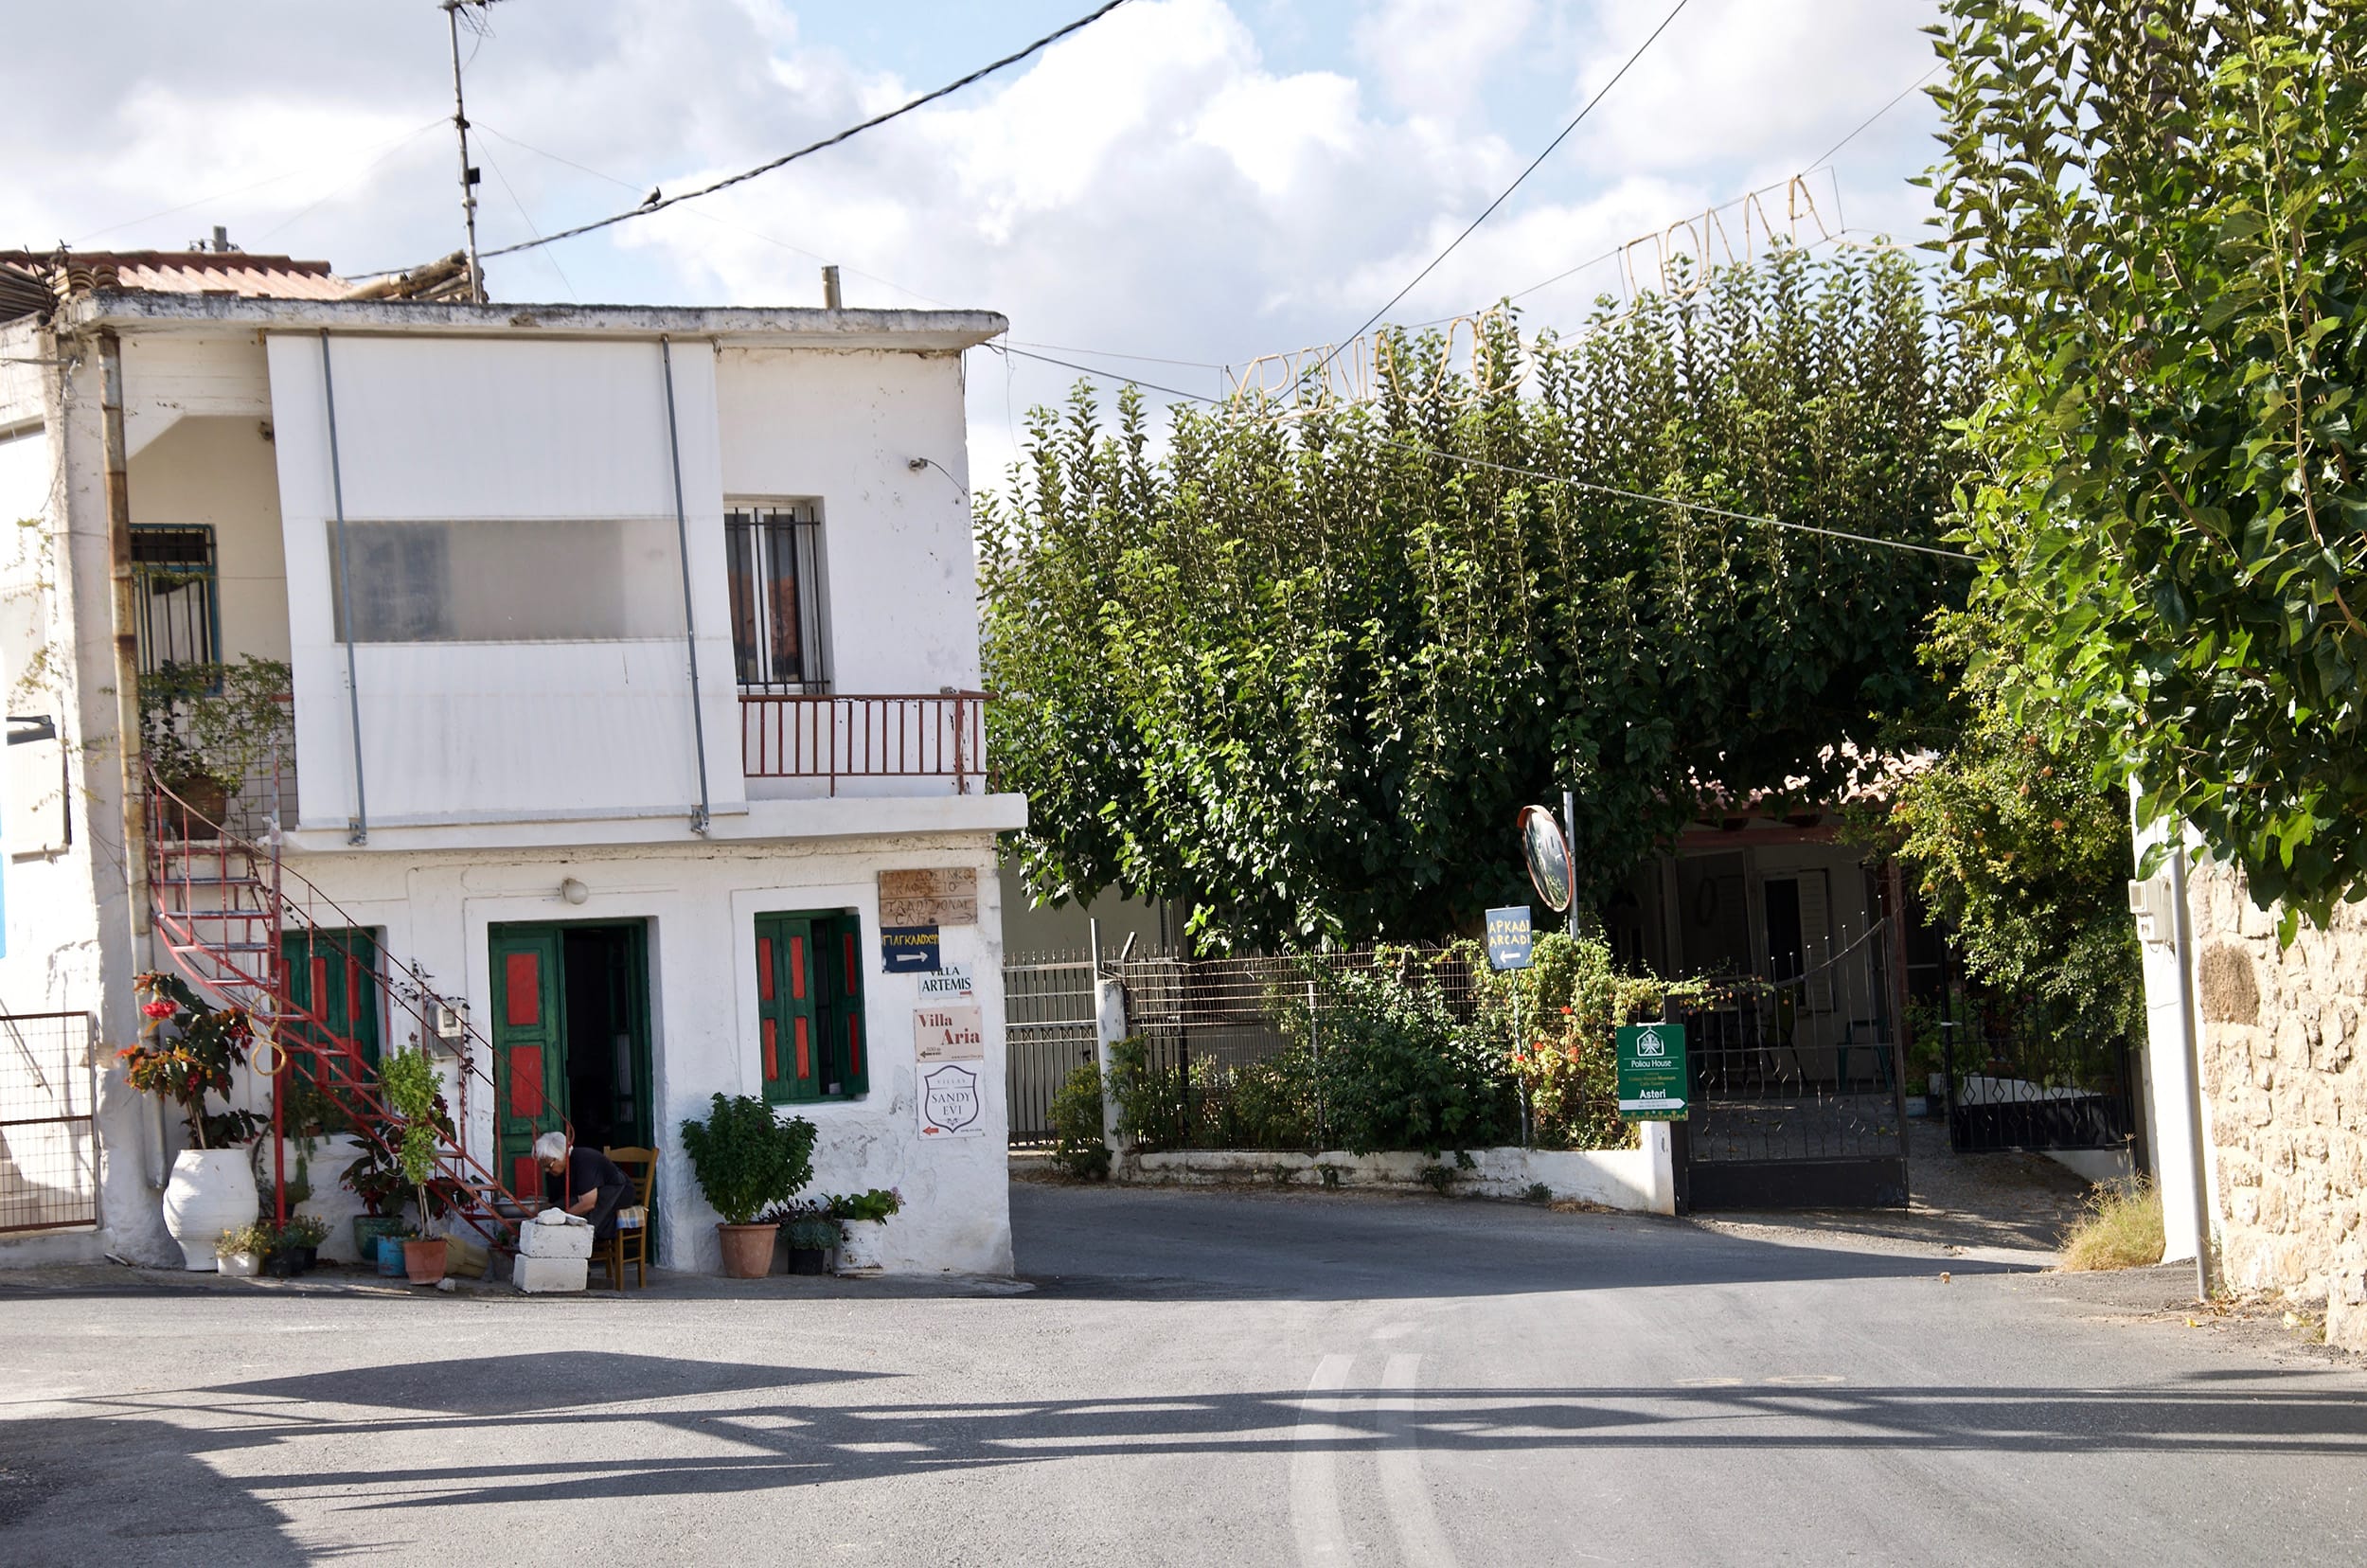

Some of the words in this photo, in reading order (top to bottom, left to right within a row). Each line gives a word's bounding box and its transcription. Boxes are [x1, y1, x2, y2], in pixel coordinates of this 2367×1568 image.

[1488, 919, 1530, 934] ΑΡΚΑΔΙ
[1488, 934, 1531, 948] ARCADI
[929, 967, 960, 976] VILLA
[922, 977, 971, 992] ARTEMIS
[918, 1013, 952, 1027] Villa
[939, 1026, 980, 1046] Aria
[931, 1092, 970, 1103] SANDY
[1639, 1089, 1666, 1099] Asteri
[943, 1105, 962, 1115] EVI
